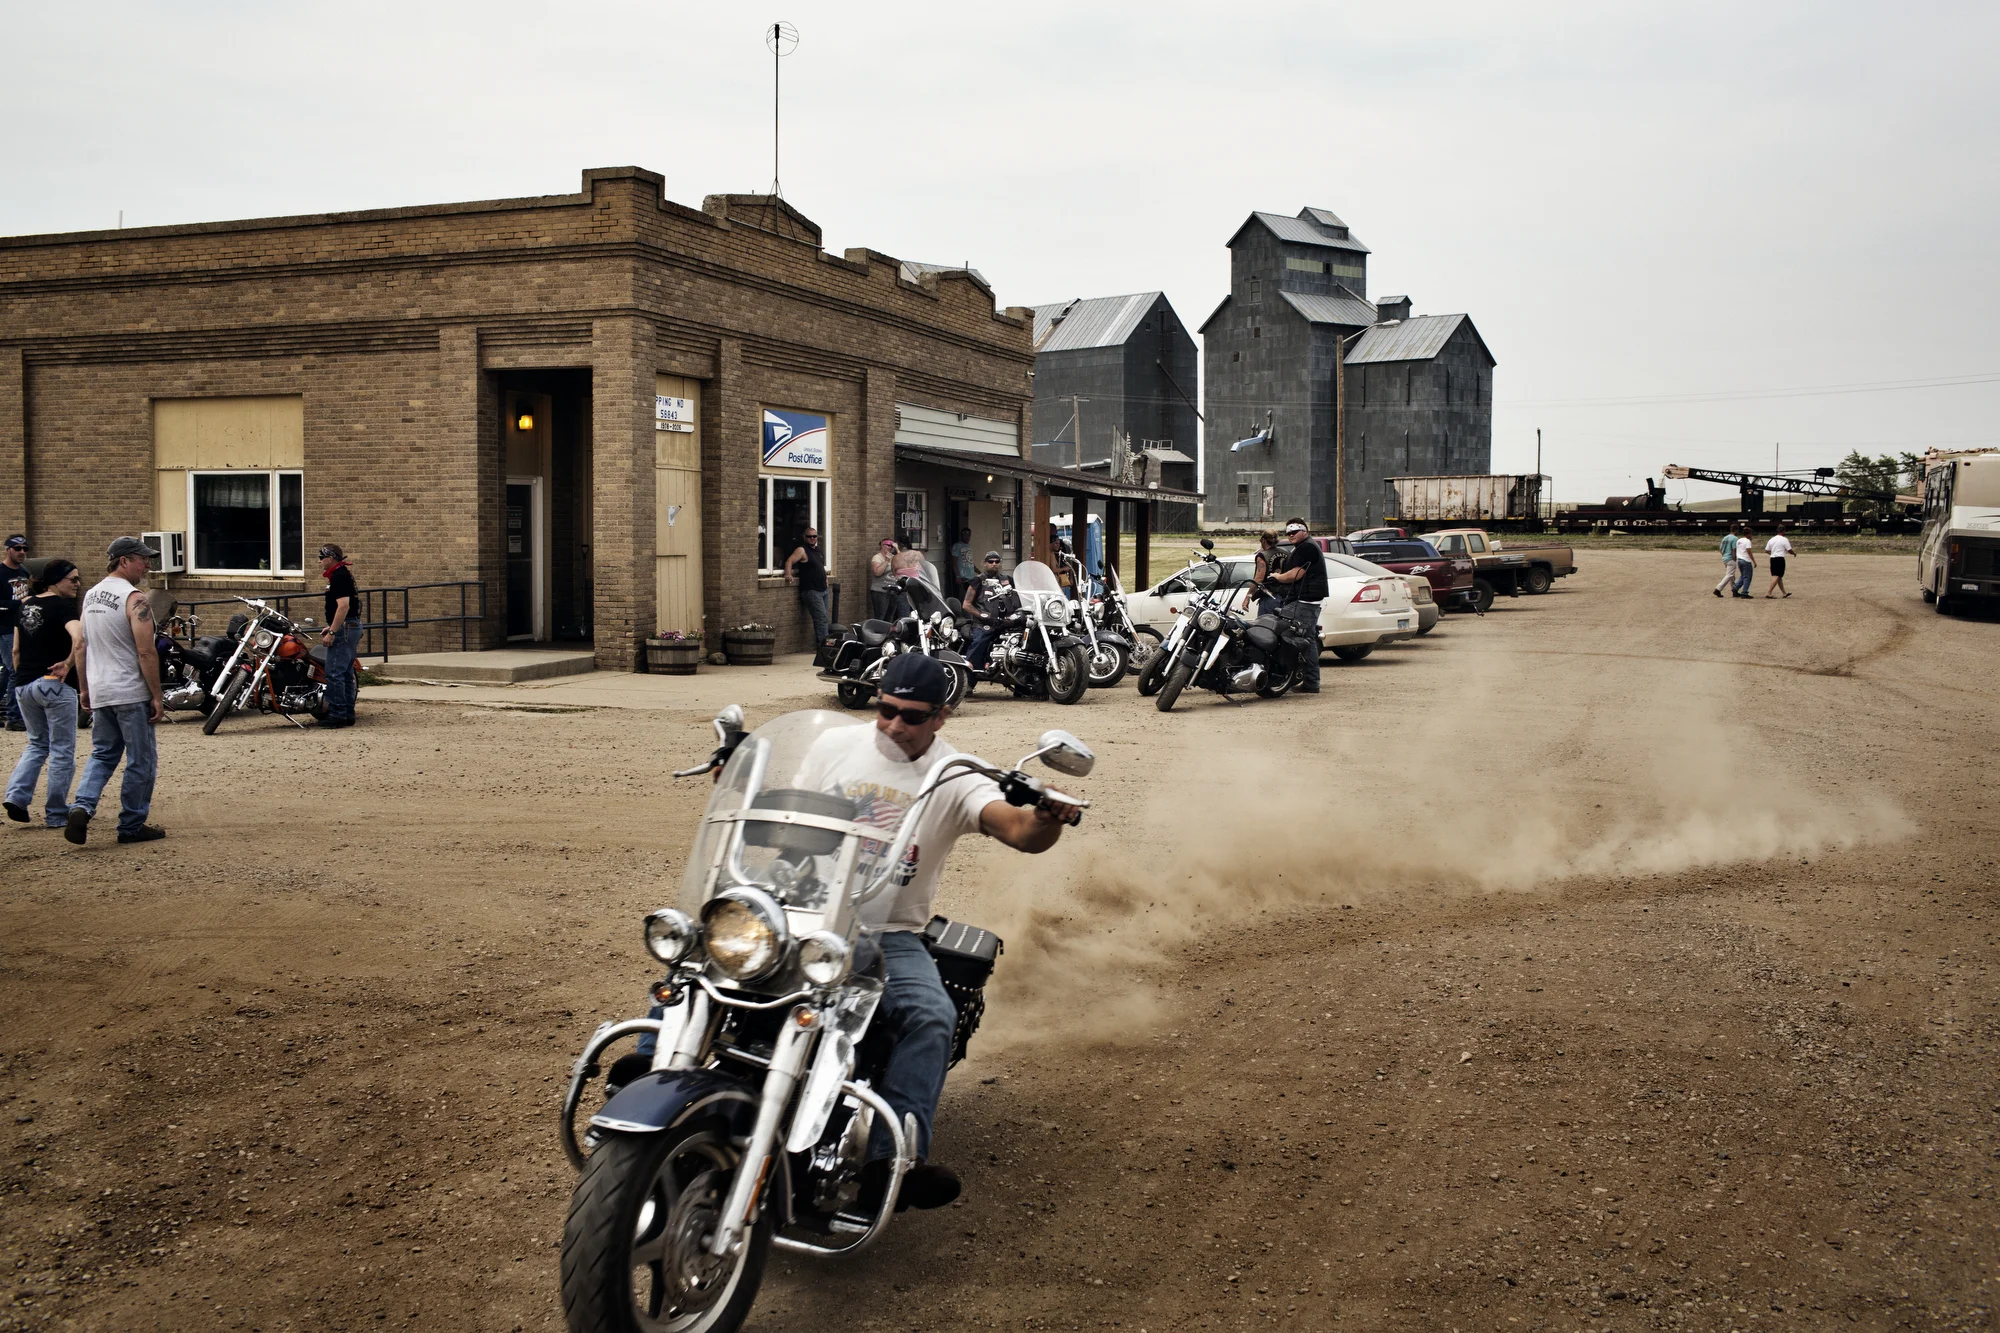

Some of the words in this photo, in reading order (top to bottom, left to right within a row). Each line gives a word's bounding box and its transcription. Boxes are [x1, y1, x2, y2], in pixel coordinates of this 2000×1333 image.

[660, 409, 677, 420] 58843
[788, 451, 803, 463] Post
[803, 453, 823, 465] Office
[100, 590, 120, 603] CITY
